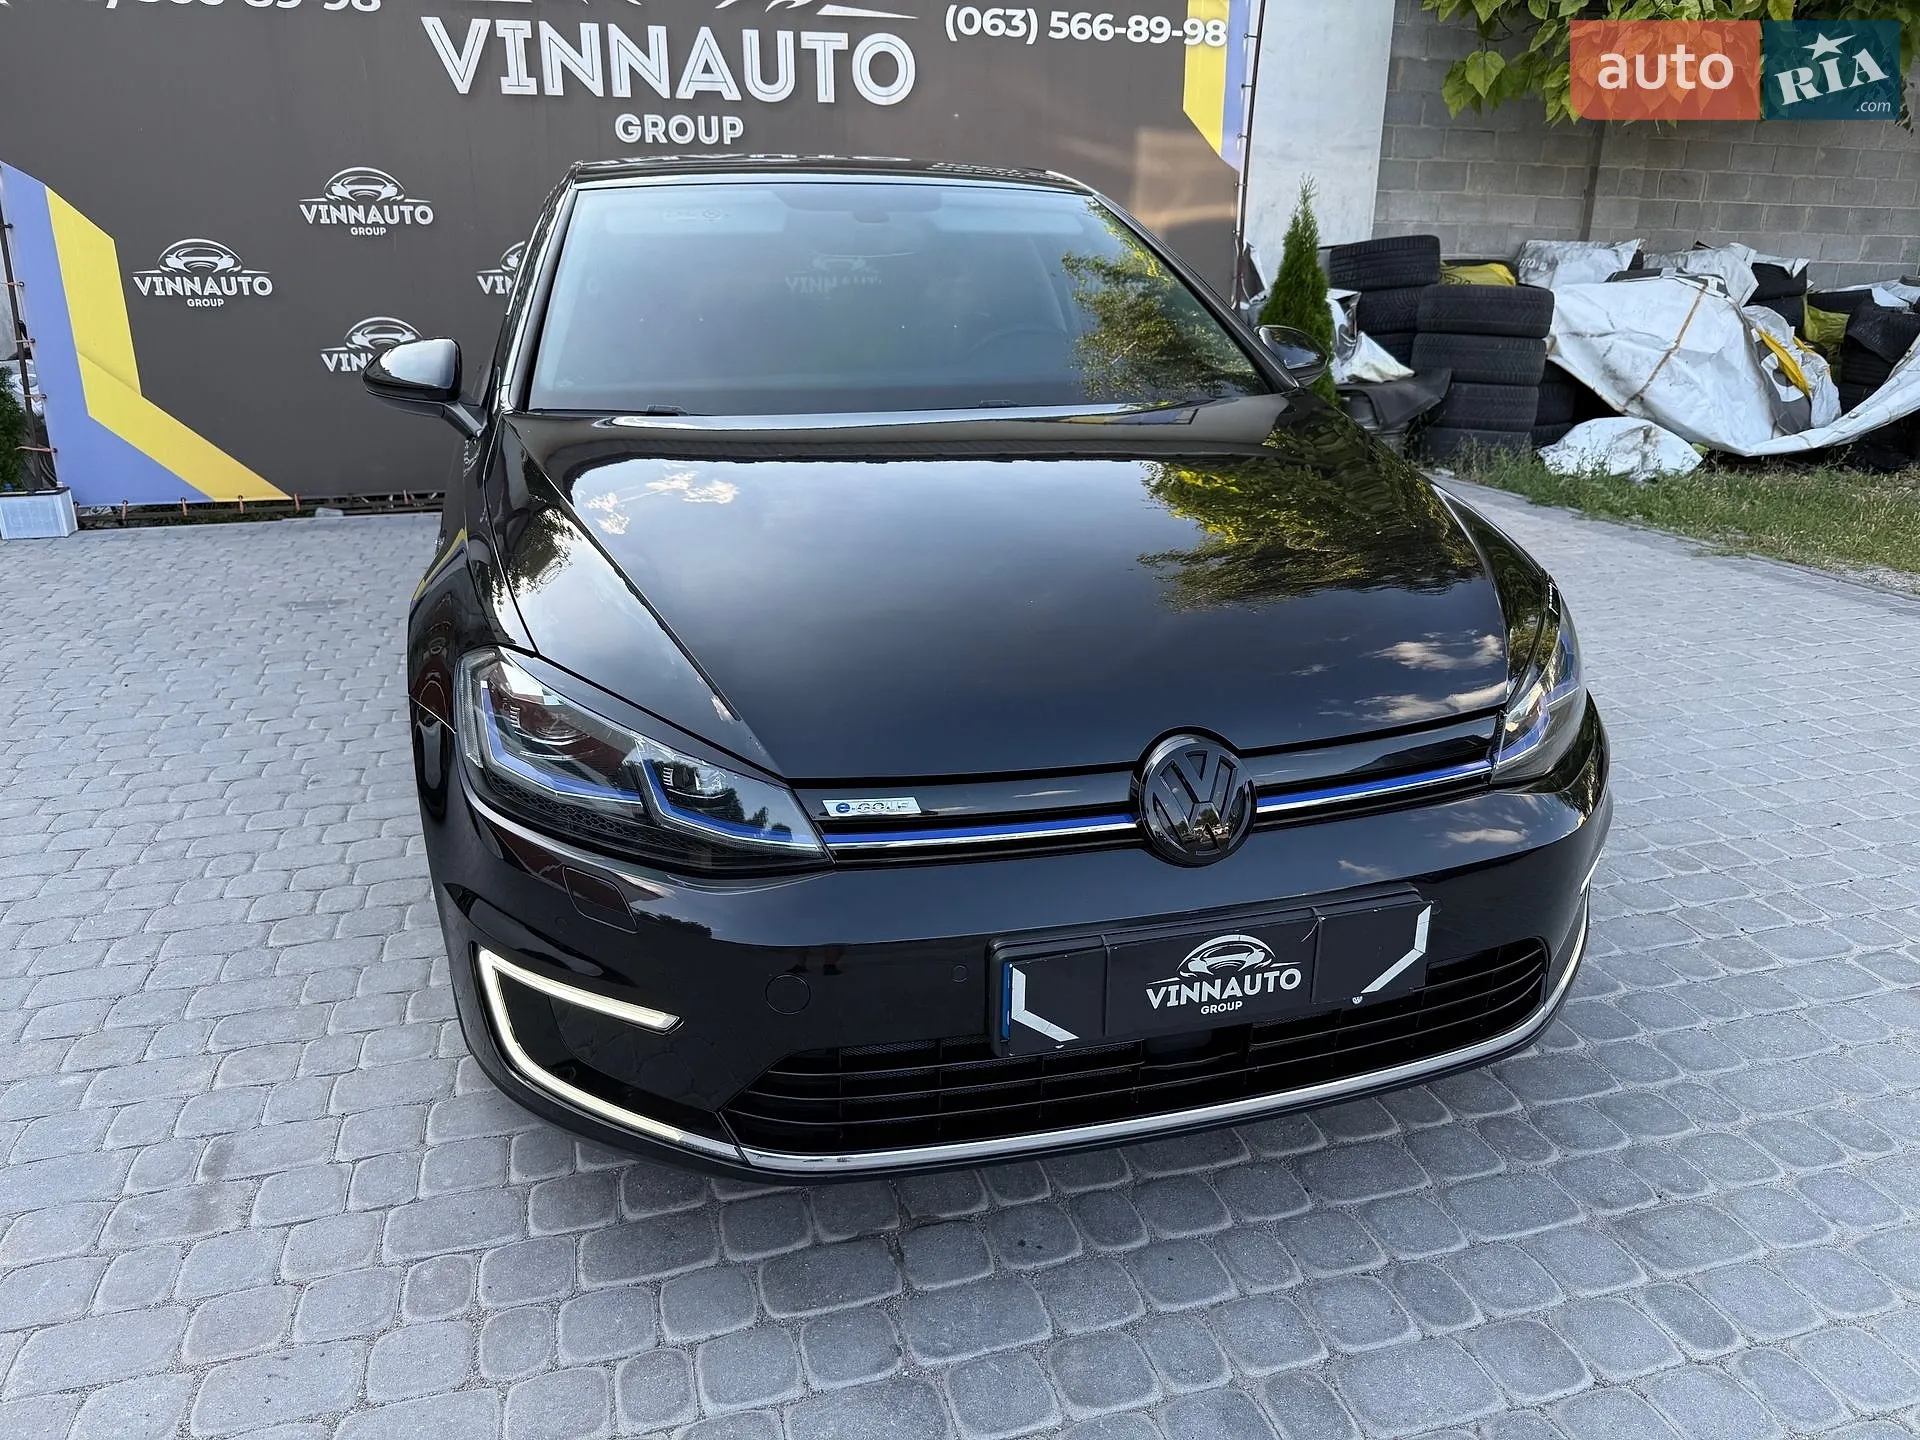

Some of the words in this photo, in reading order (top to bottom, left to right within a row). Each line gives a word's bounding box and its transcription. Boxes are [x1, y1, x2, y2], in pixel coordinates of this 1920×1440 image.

[945, 4, 1039, 44] (063)
[1048, 11, 1227, 47] 566-89-98
[421, 16, 916, 106] VINNAUTO
[614, 113, 744, 145] GROUP
[299, 203, 434, 225] VINNAUTO
[350, 226, 386, 236] GROUP
[132, 275, 273, 297] VINNAUTO
[186, 298, 224, 308] GROUP
[1145, 968, 1302, 1010] VINNAUTO
[1200, 1000, 1243, 1015] GROUP
